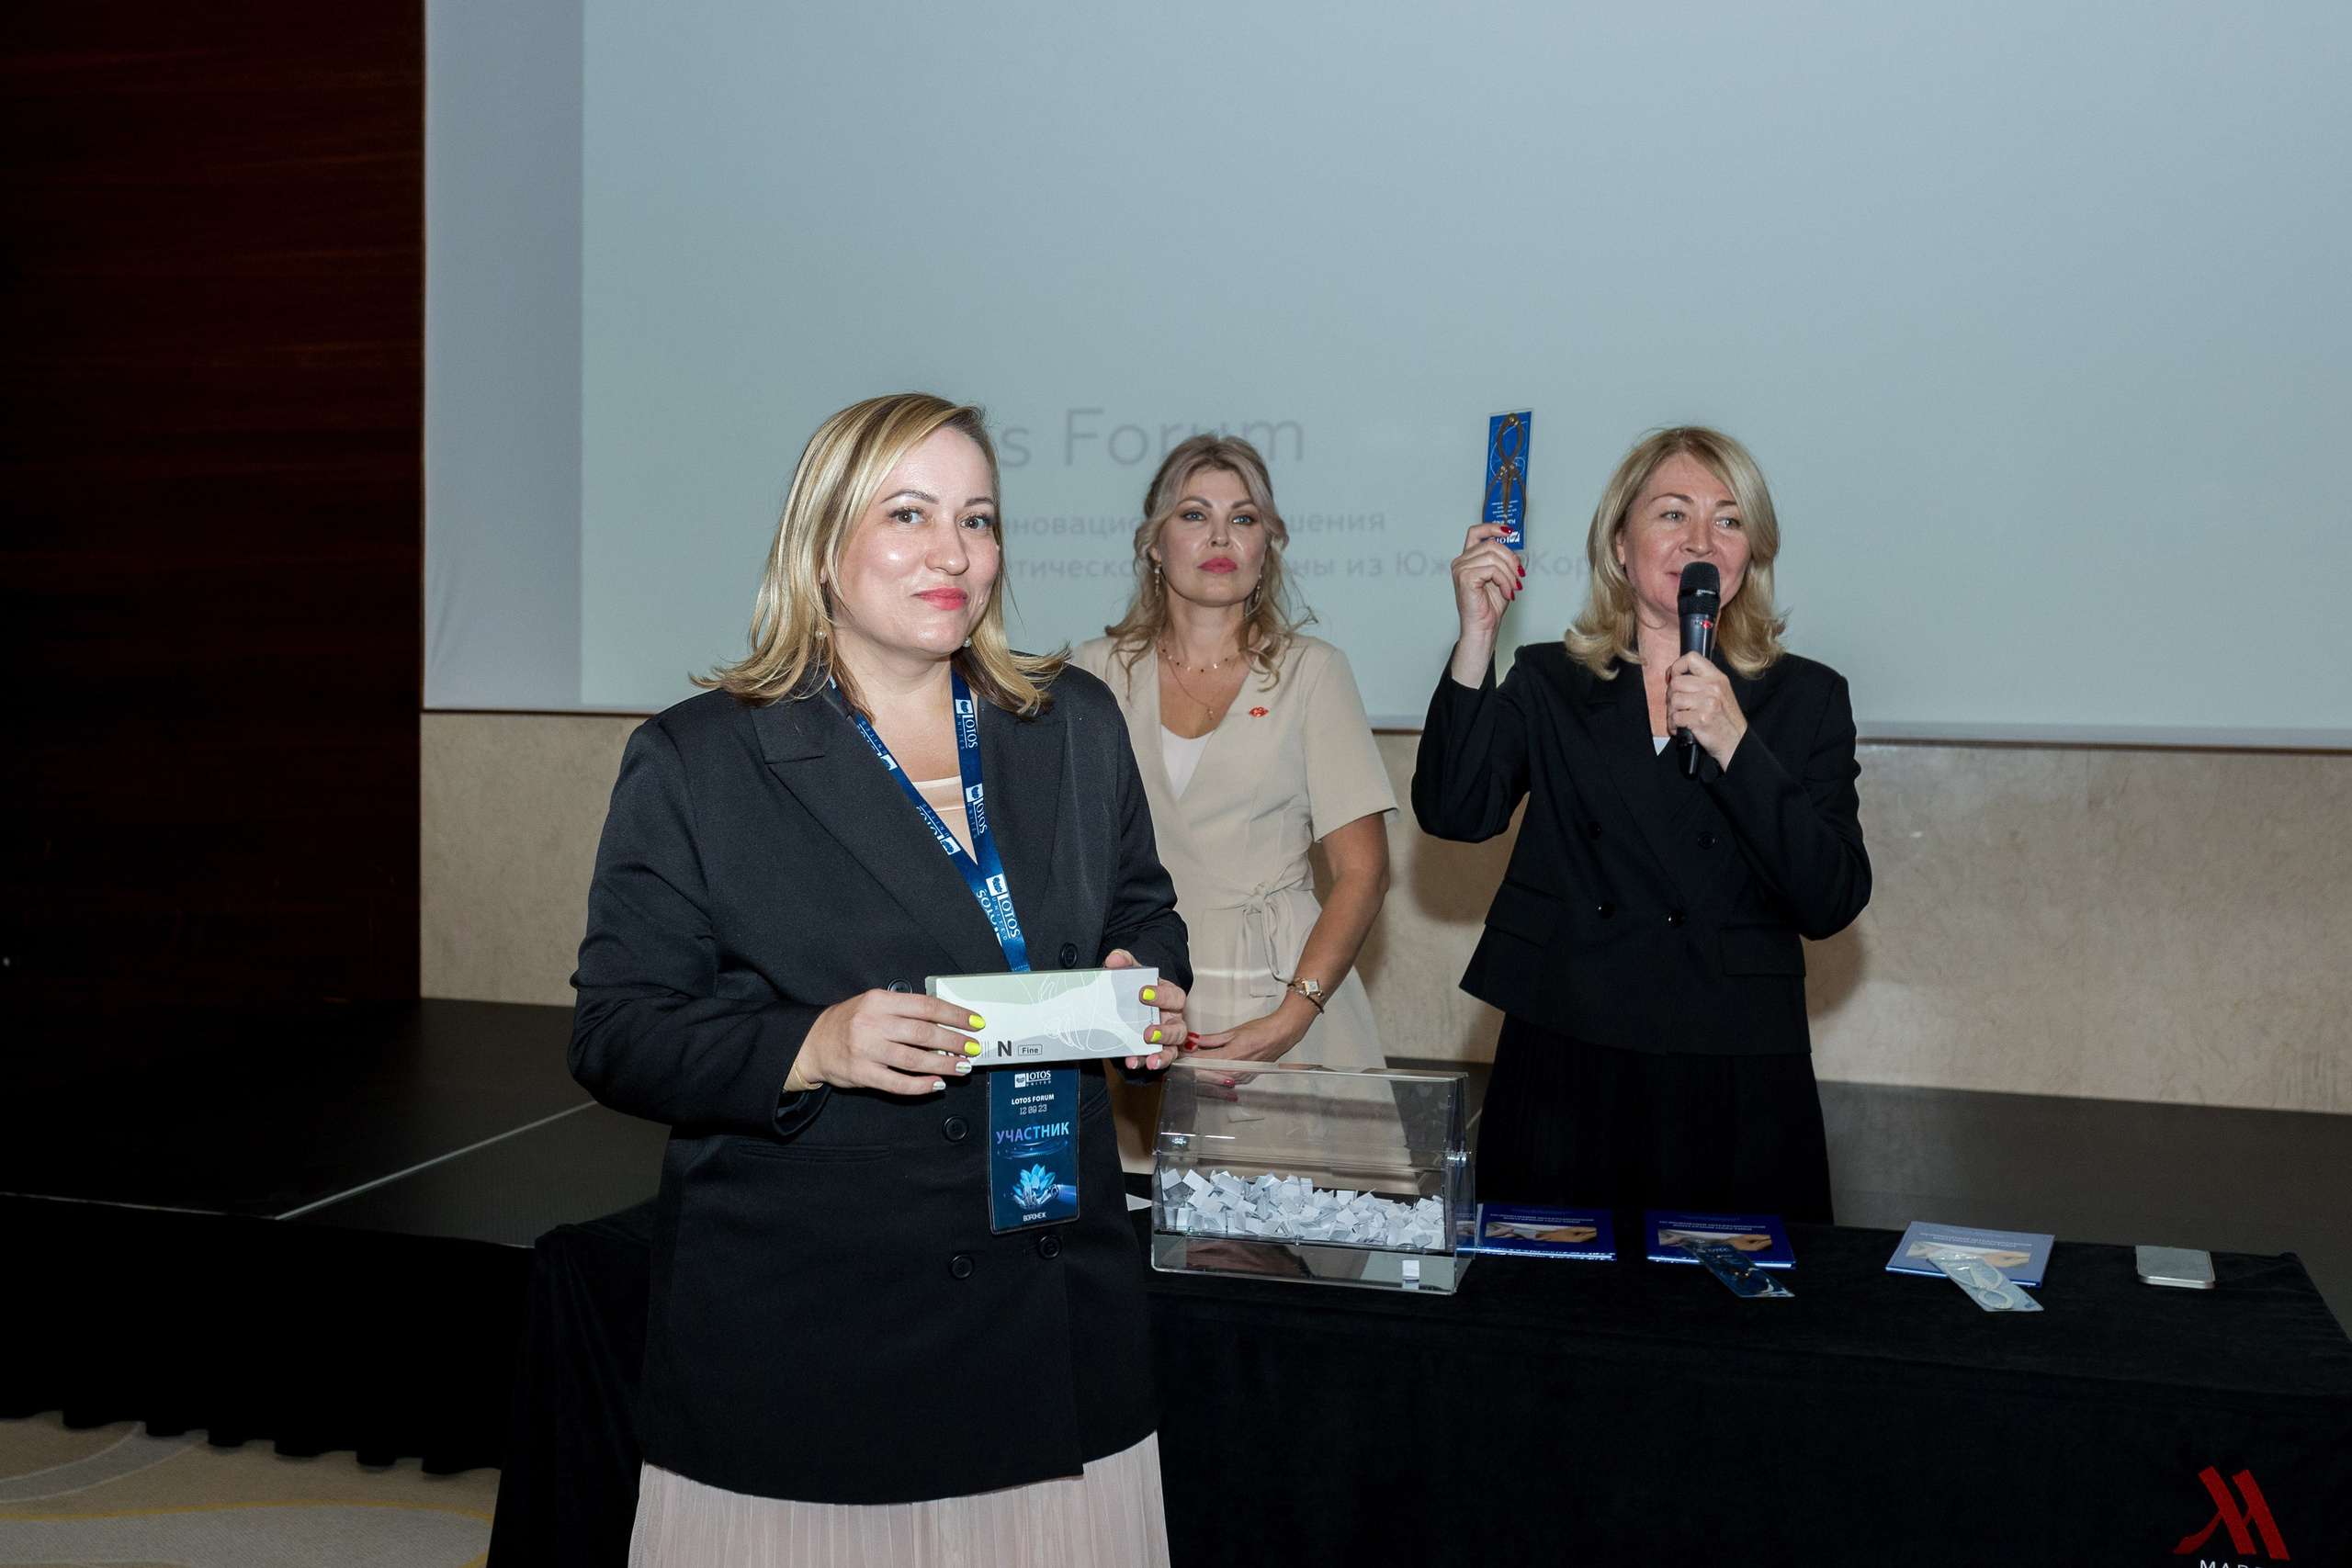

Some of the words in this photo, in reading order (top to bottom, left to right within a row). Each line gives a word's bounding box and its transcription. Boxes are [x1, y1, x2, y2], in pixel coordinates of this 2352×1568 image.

[1066, 407, 1305, 467] Form
[1013, 558, 1134, 579] тическо
[1347, 558, 1383, 577] из
[962, 714, 978, 749] LOTOS
[997, 893, 1021, 939] LOTOS
[1022, 1046, 1039, 1055] Fine
[1025, 1070, 1052, 1083] LOTOS
[1011, 1096, 1031, 1105] LOTOS
[1032, 1093, 1055, 1103] FORUM
[1019, 1106, 1027, 1115] 12
[1037, 1103, 1047, 1112] 23
[995, 1122, 1069, 1145] УЧАСТНИК
[1023, 1212, 1046, 1222] ВОРОНЕЖ
